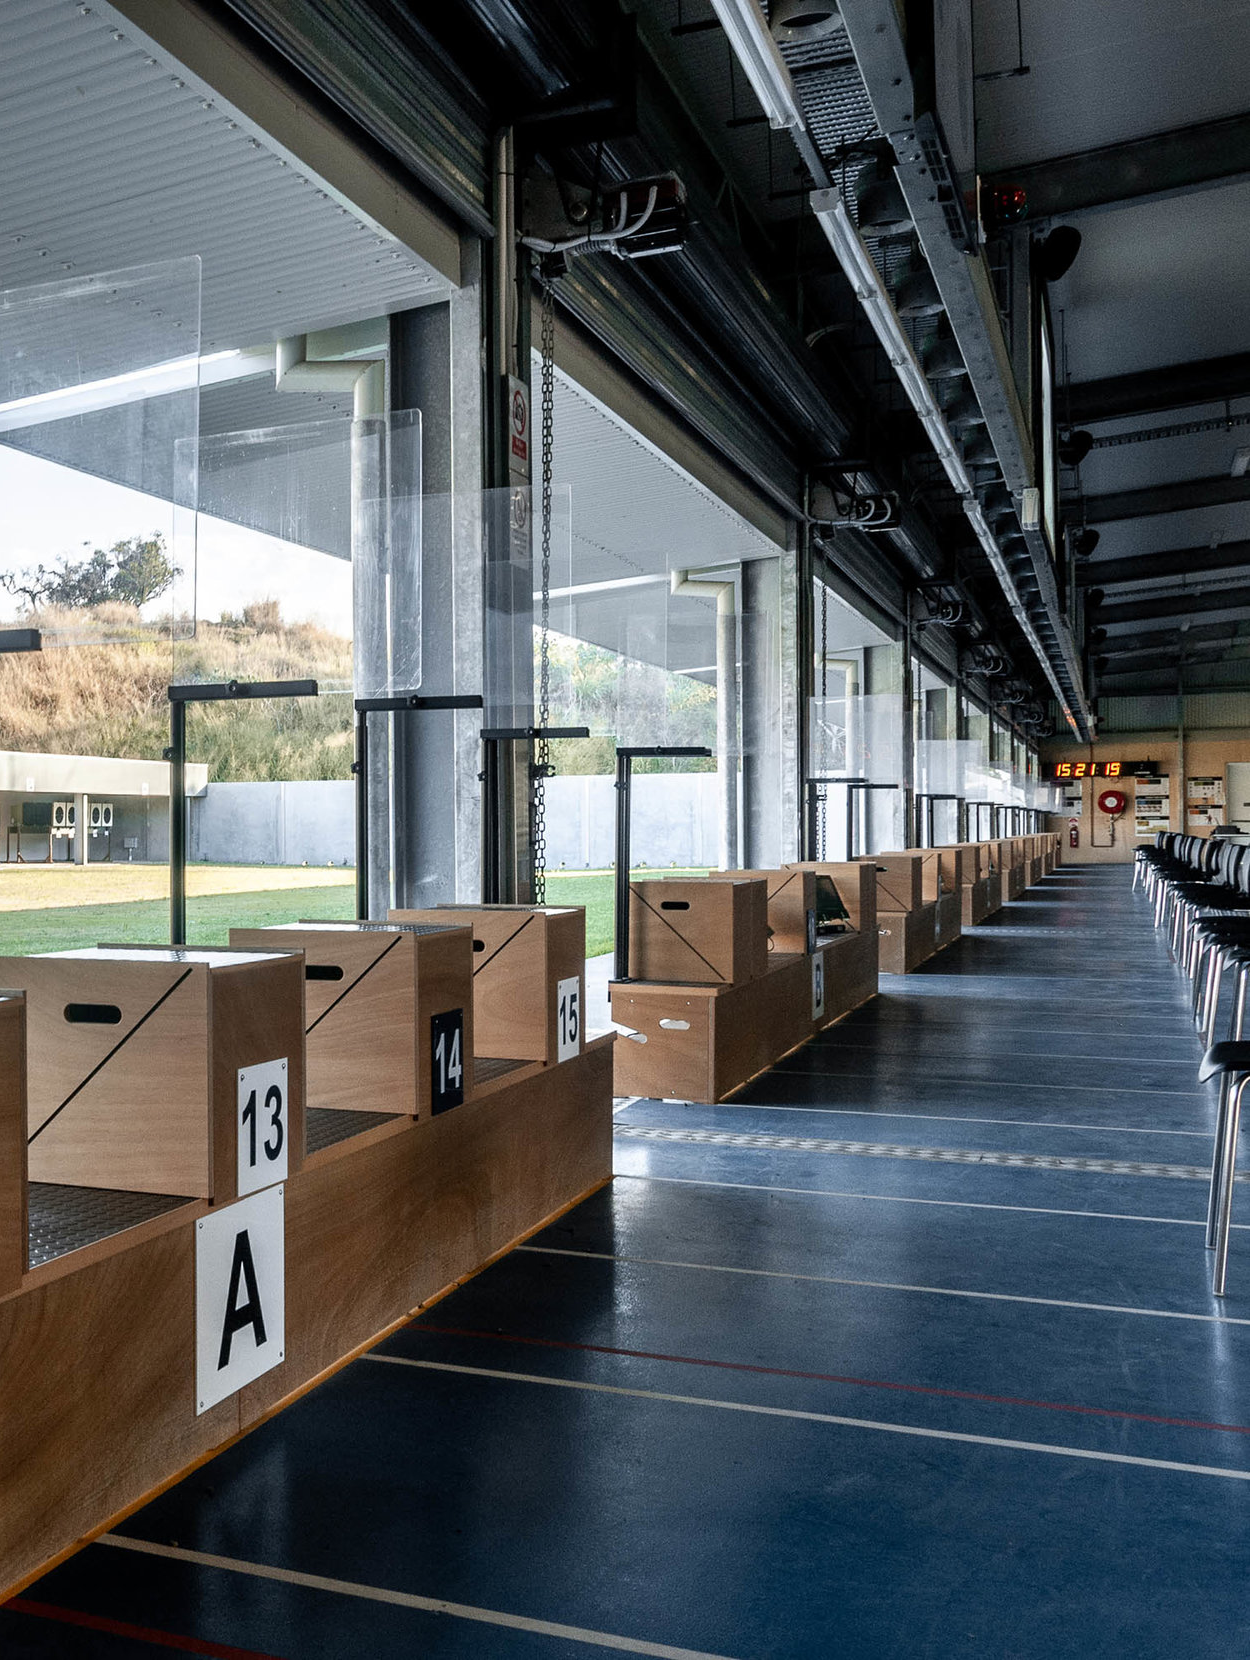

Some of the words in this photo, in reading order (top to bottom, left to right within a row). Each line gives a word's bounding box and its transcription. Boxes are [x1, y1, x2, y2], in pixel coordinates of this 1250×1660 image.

[559, 993, 578, 1045] 15
[435, 1028, 462, 1094] 14
[242, 1084, 284, 1168] 13
[217, 1228, 268, 1372] A
